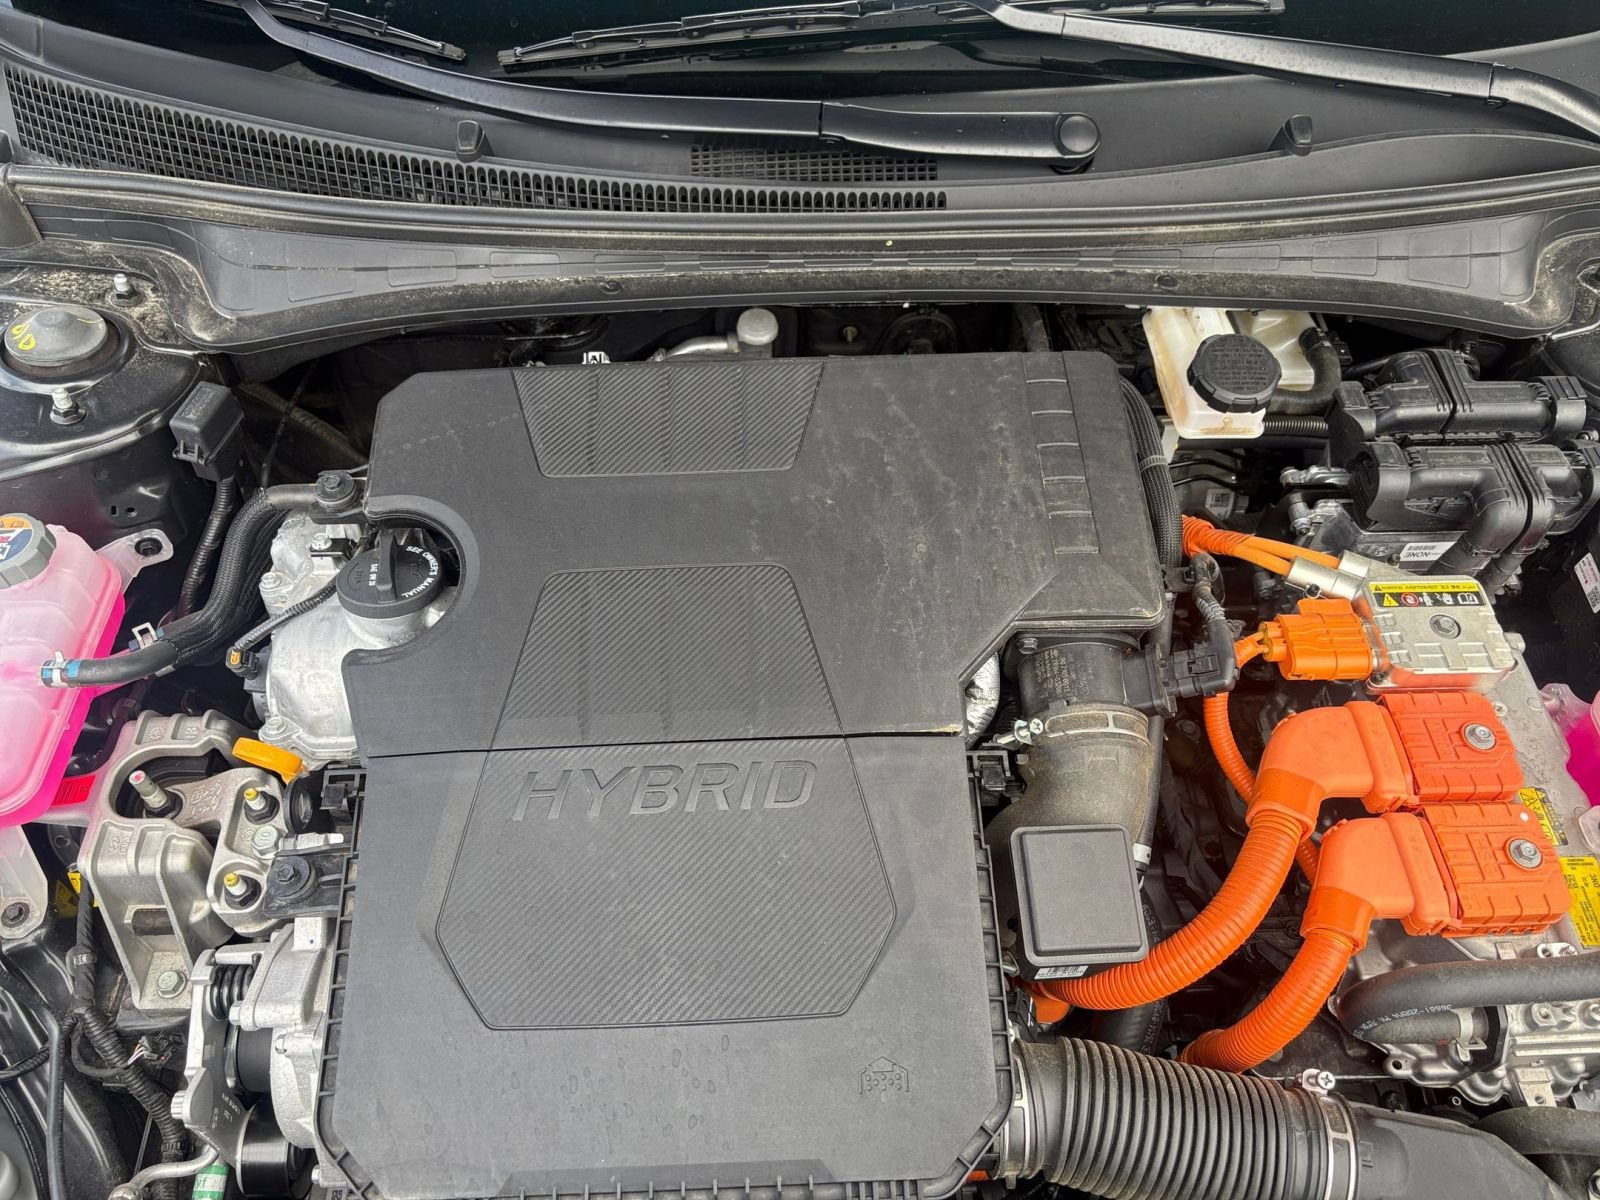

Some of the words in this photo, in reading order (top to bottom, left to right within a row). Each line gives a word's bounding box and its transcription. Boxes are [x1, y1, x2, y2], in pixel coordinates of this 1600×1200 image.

[406, 545, 424, 554] SEE
[401, 577, 435, 599] MANUAL
[512, 760, 817, 821] HYBRID
